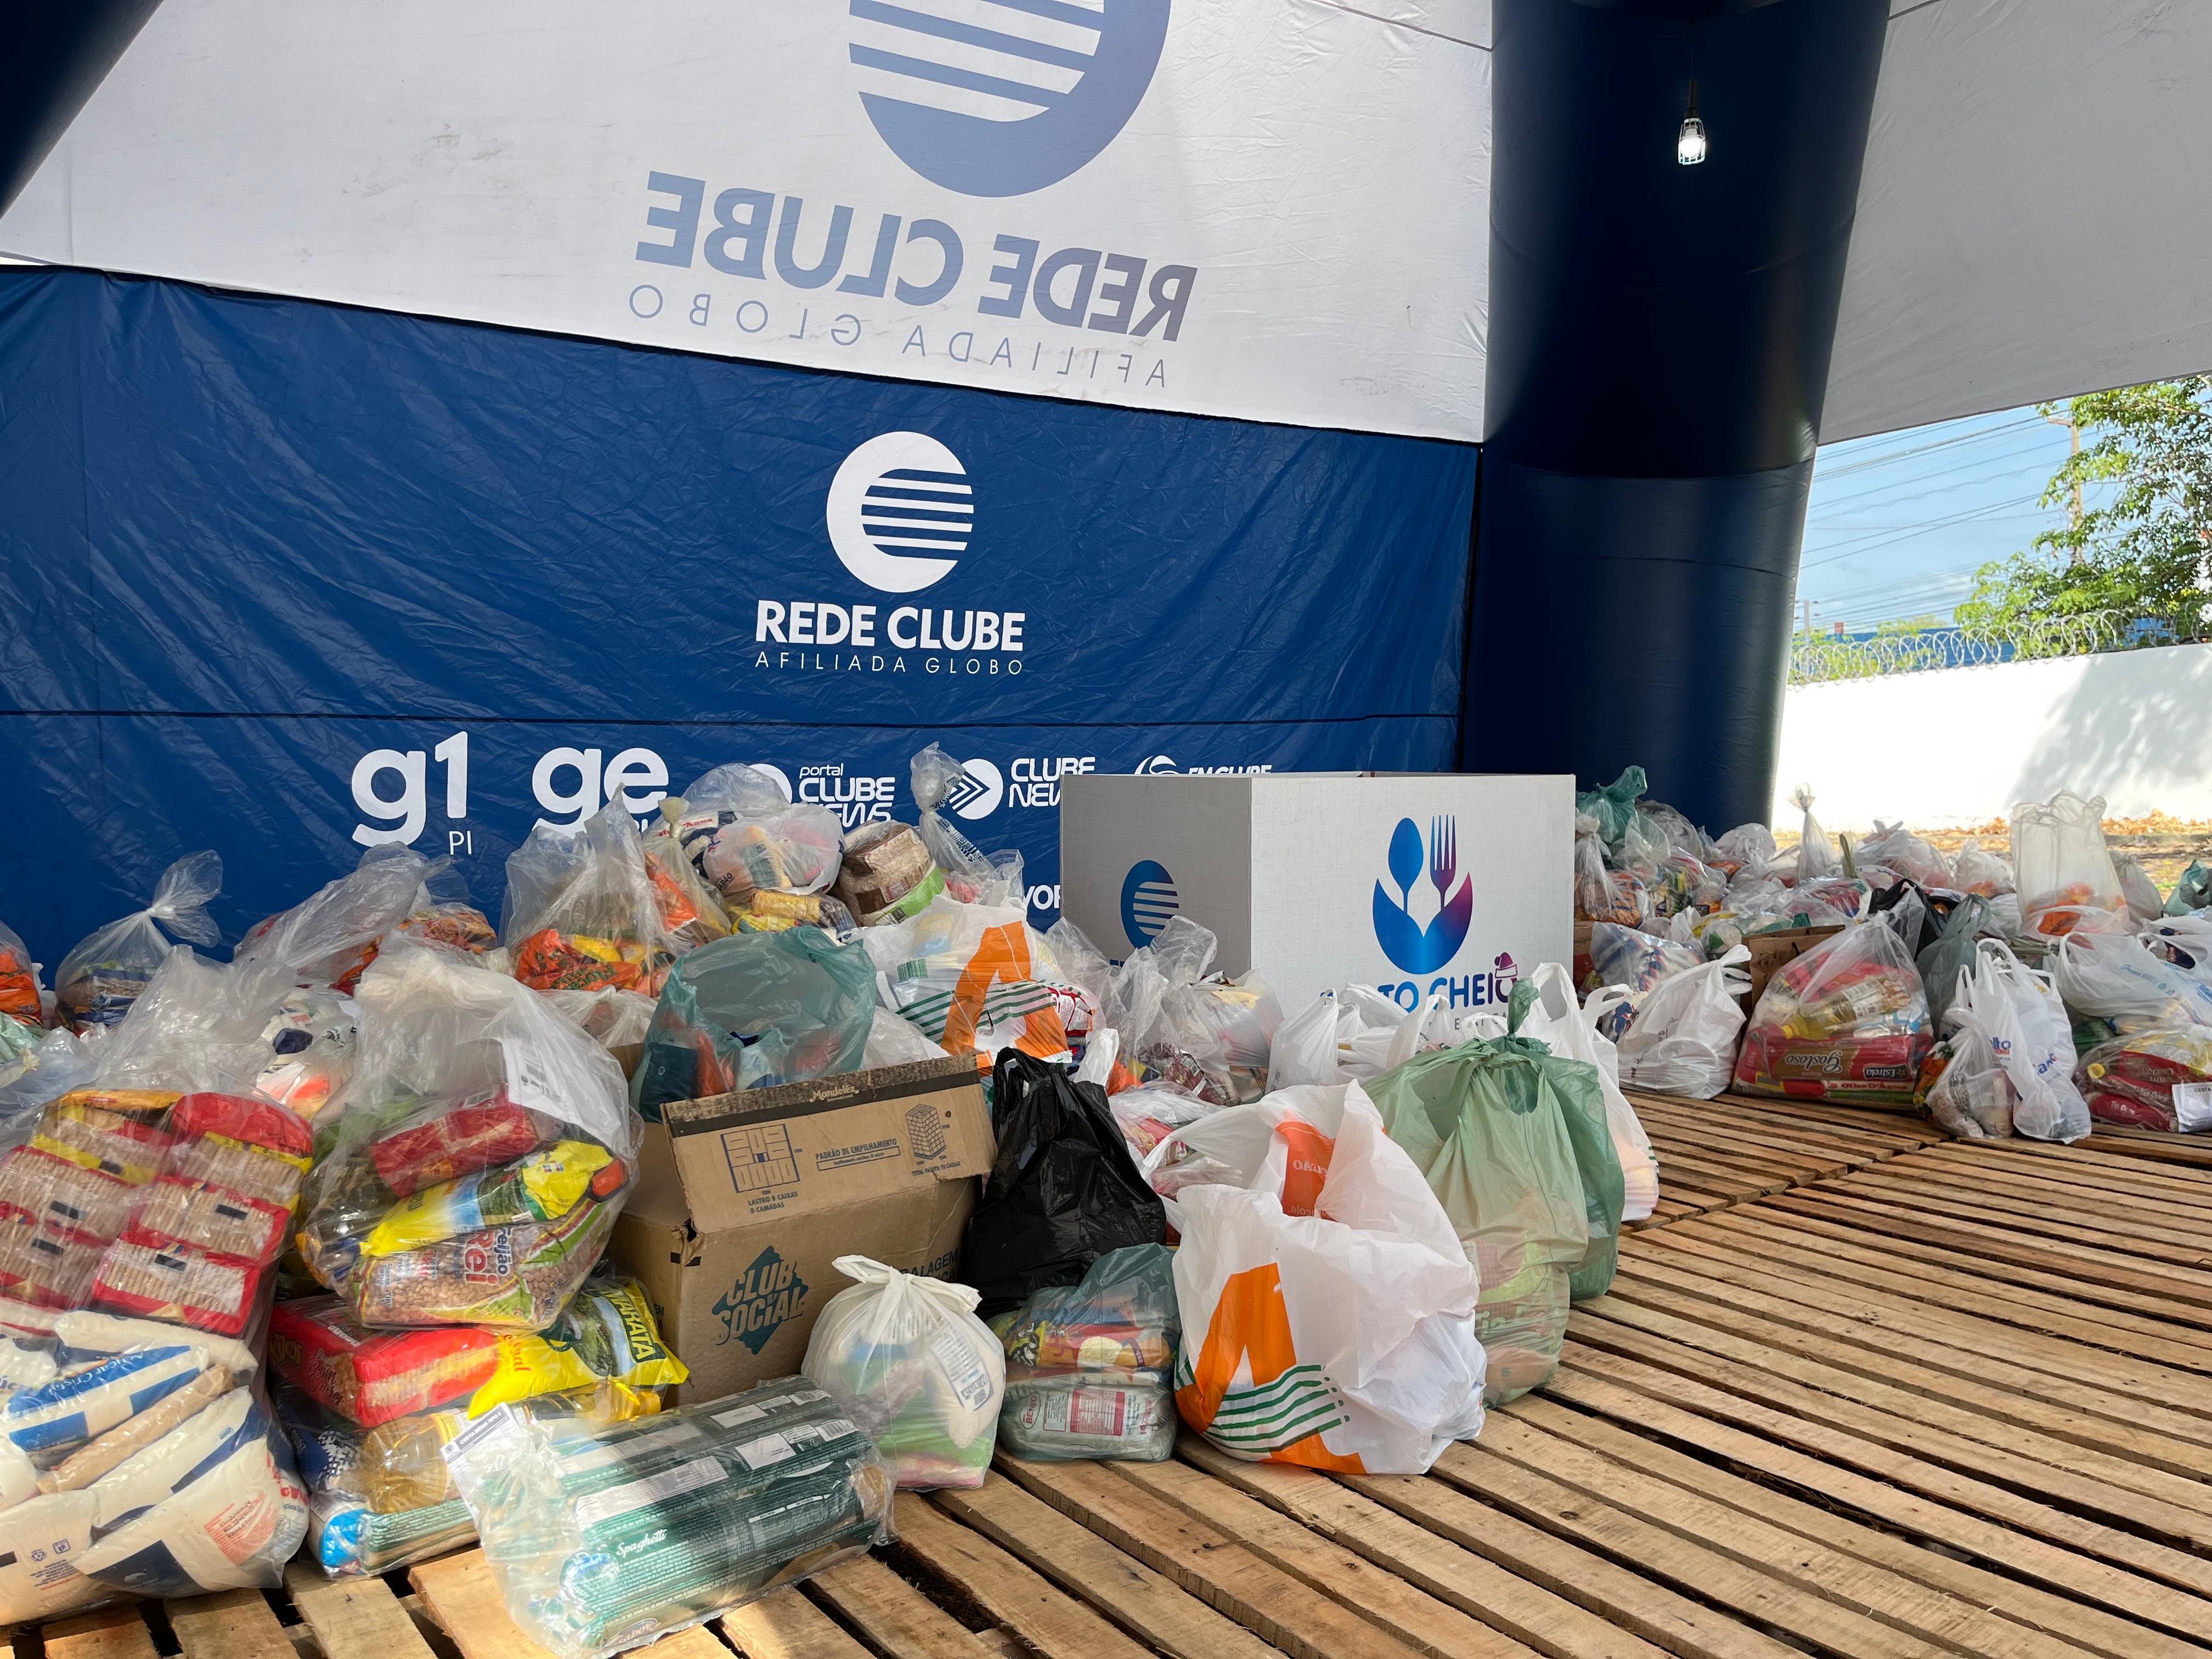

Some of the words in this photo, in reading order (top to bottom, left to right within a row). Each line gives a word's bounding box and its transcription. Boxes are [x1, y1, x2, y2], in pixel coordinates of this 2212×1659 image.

[755, 600, 877, 647] REDE
[887, 606, 1026, 652] CLUBE
[755, 651, 906, 673] AFILIADA
[925, 657, 1023, 675] GLOBO
[799, 763, 844, 780] portal
[1011, 756, 1096, 782] CLUBE
[351, 731, 468, 848] g1
[532, 747, 669, 839] ge
[799, 776, 895, 802] CLUBE
[449, 830, 472, 856] PI
[1785, 1049, 1843, 1074] Gostoso
[1866, 1068, 1895, 1077] Estrela
[850, 1138, 898, 1154] EMPILHAMENTO
[748, 1195, 771, 1206] LASTRO
[777, 1191, 799, 1200] CAIXAS
[756, 1202, 785, 1213] CAMADAS
[465, 1229, 500, 1286] Rei
[726, 1260, 797, 1307] CLUB
[460, 1431, 476, 1445] CESTA
[616, 1528, 668, 1558] Spaghetti
